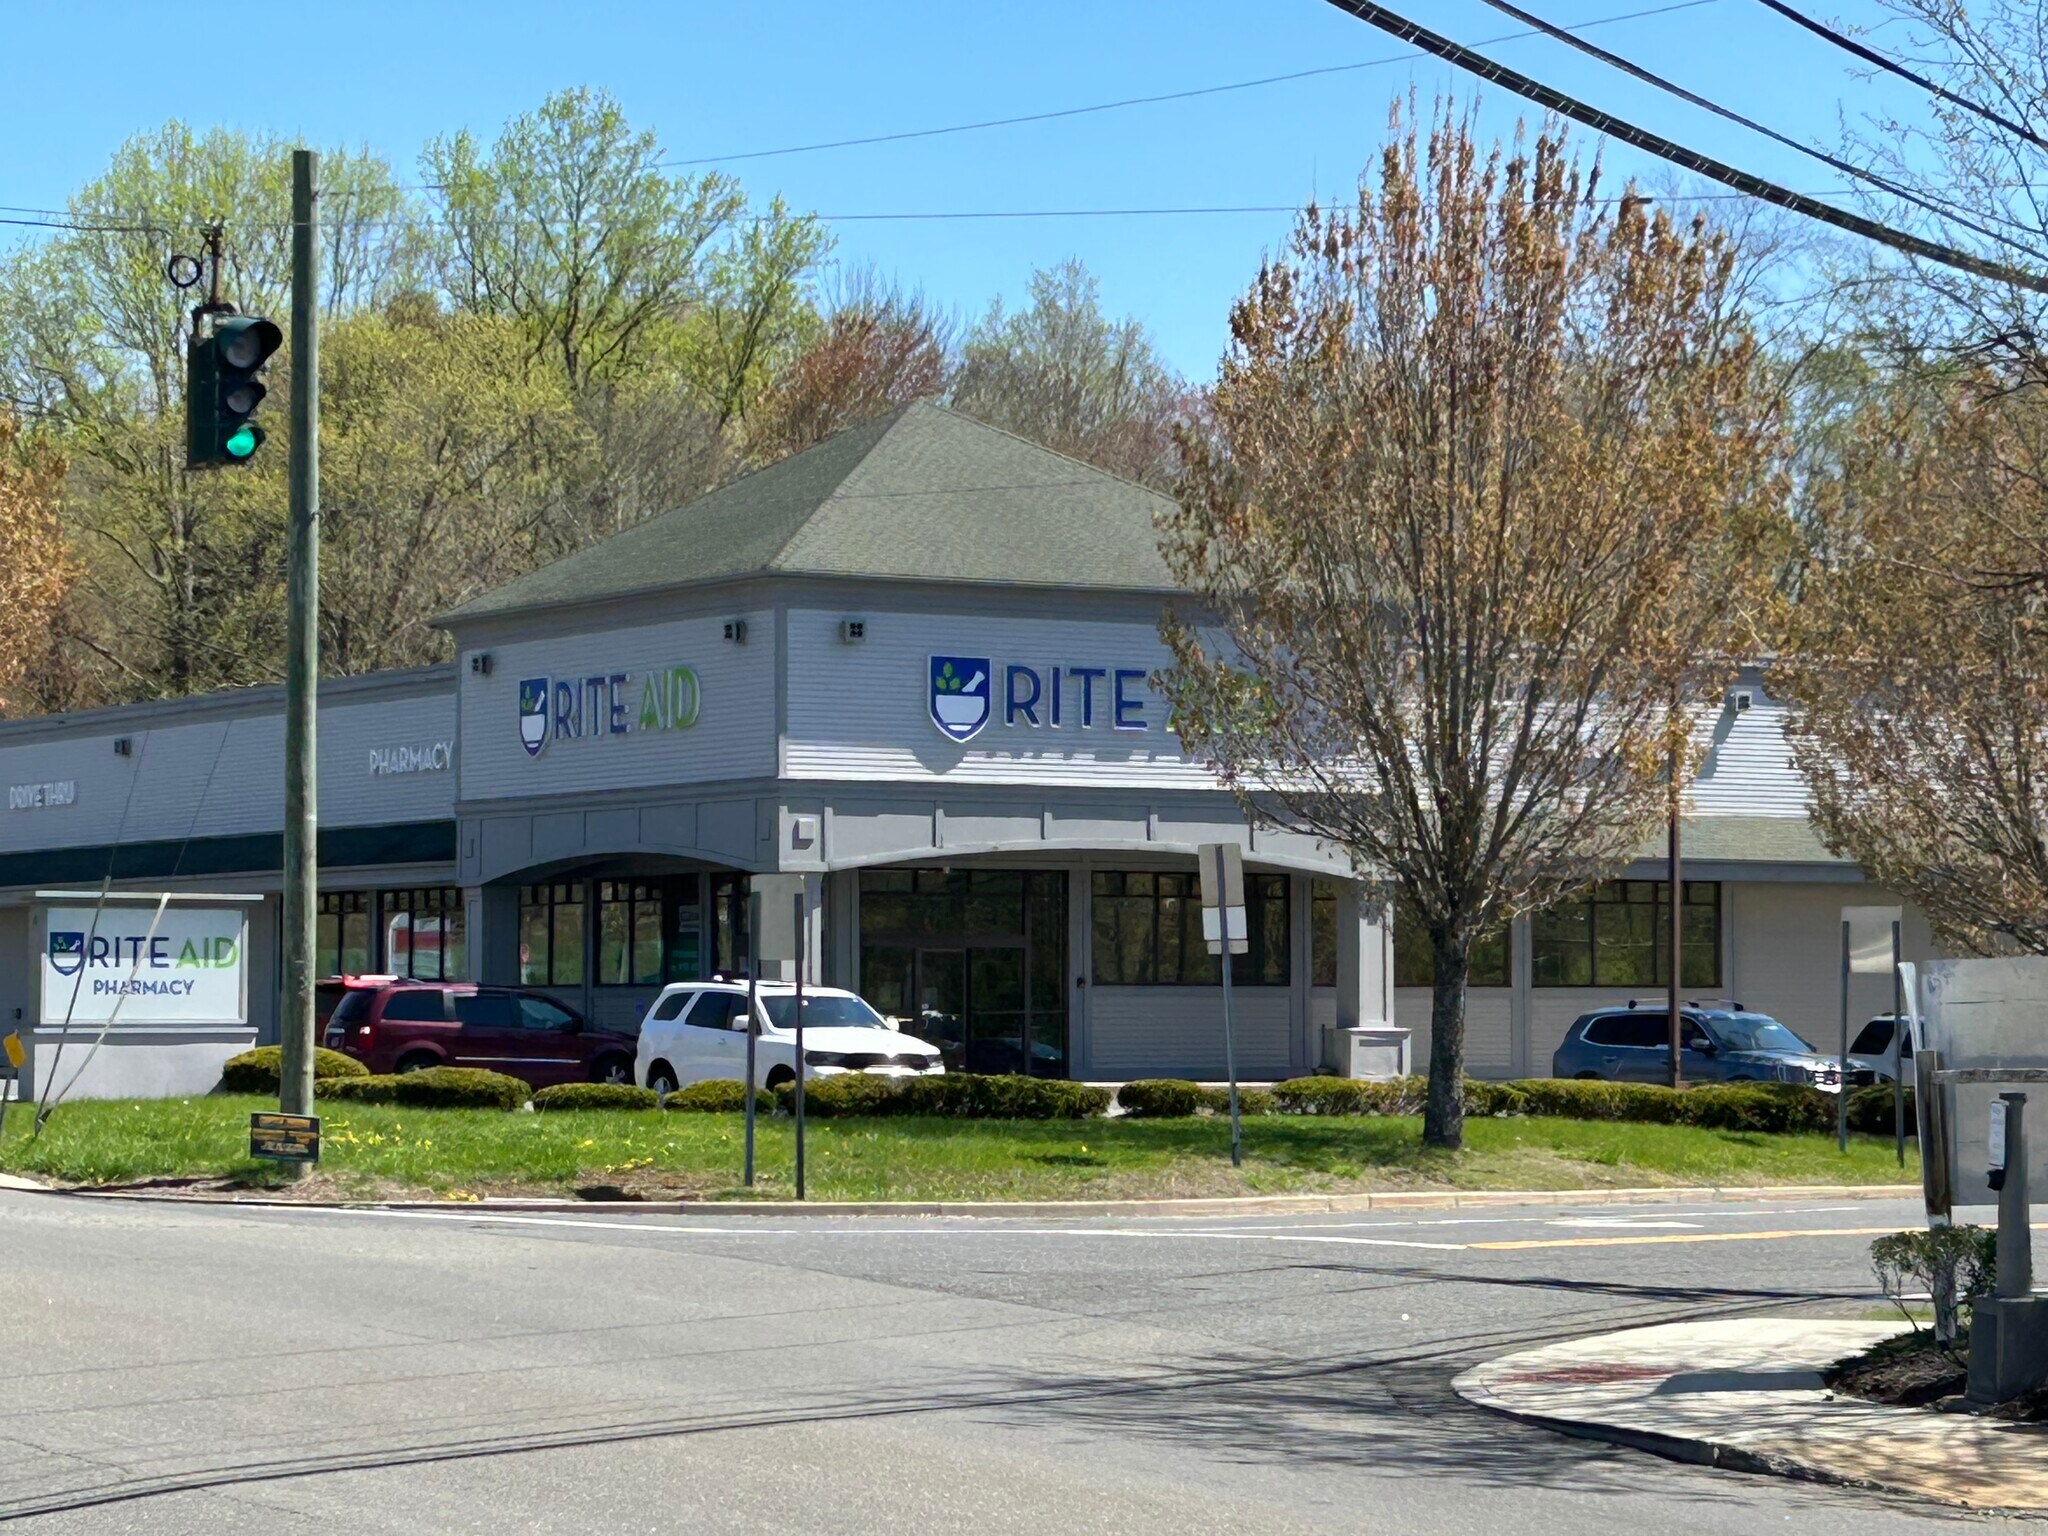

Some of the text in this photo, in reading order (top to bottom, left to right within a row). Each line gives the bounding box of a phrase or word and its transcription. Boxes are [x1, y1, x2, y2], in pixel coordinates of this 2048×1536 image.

[555, 667, 700, 740] RITE AID
[1005, 665, 1148, 731] RITE
[369, 741, 454, 775] PHARMACY
[89, 936, 238, 969] RITE AID
[94, 979, 195, 995] PHARMACY
